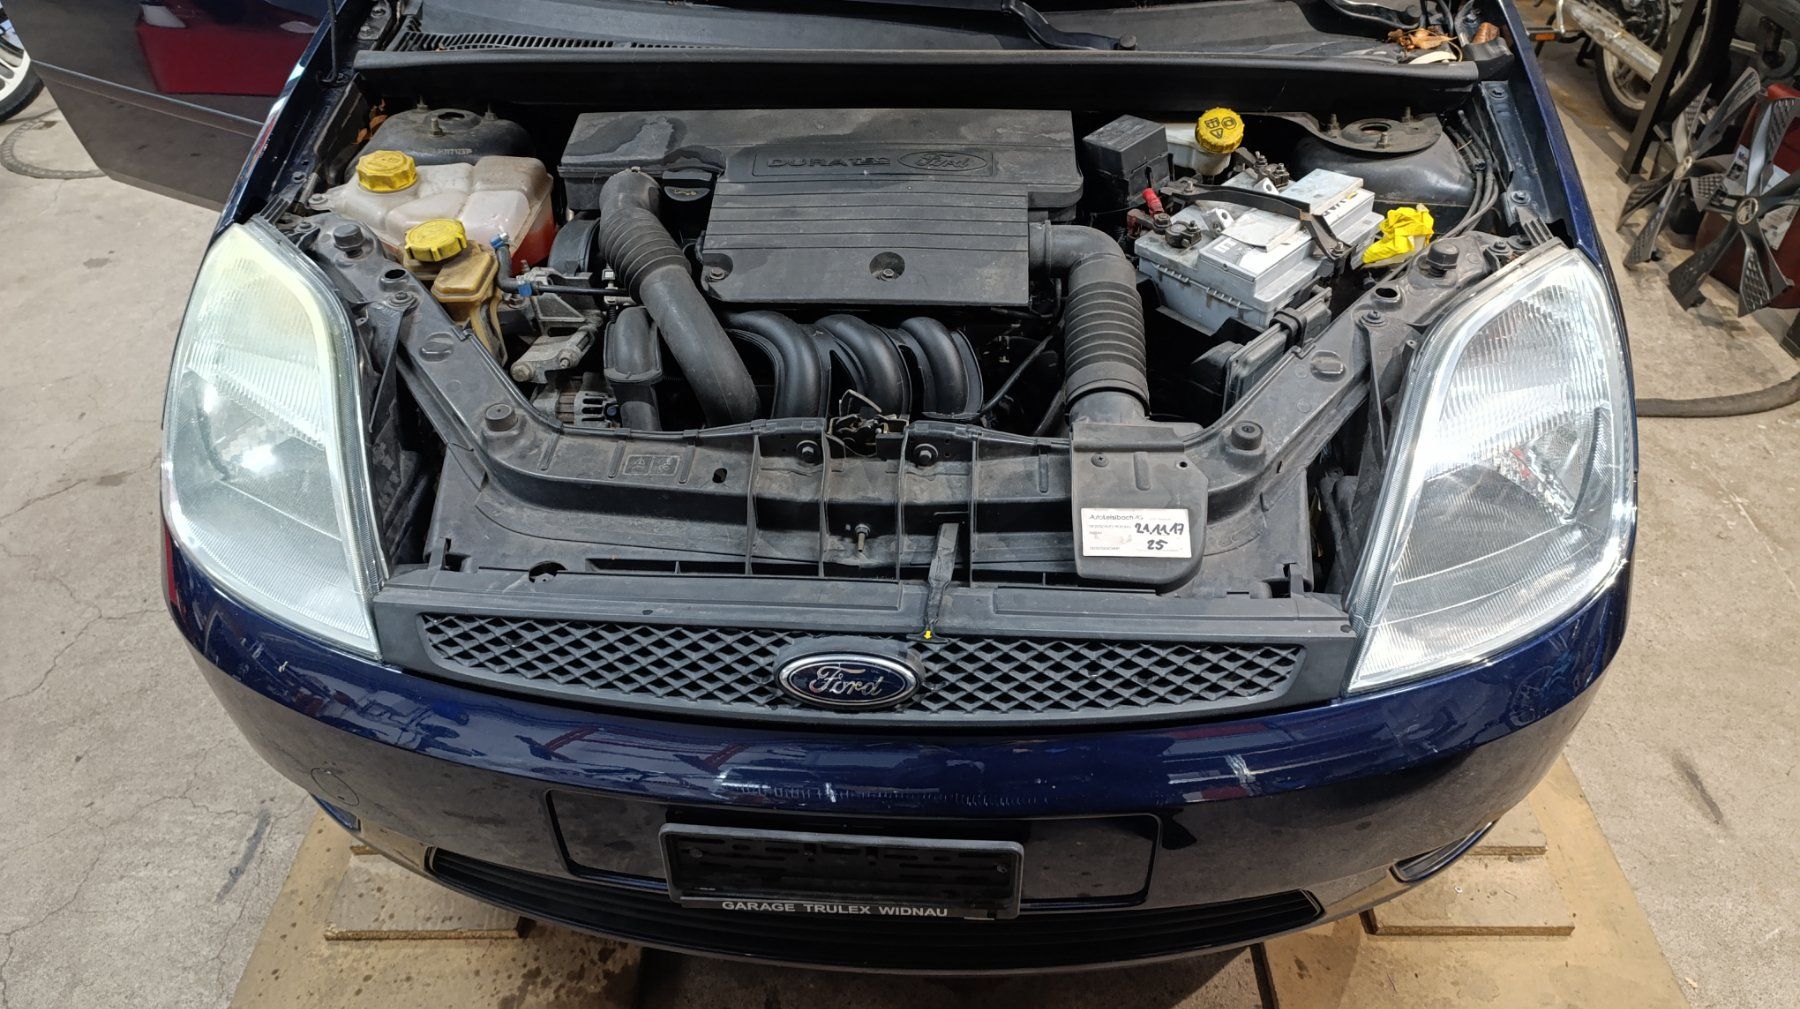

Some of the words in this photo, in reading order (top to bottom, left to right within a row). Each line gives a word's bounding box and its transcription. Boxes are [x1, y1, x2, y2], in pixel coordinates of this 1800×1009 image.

[768, 157, 891, 168] DURATEC
[914, 151, 970, 169] Ford
[1147, 539, 1168, 551] 25
[808, 665, 886, 697] Ford
[721, 900, 796, 913] GARAGE
[803, 902, 872, 915] TRULEX
[878, 904, 949, 918] WIDNAU
